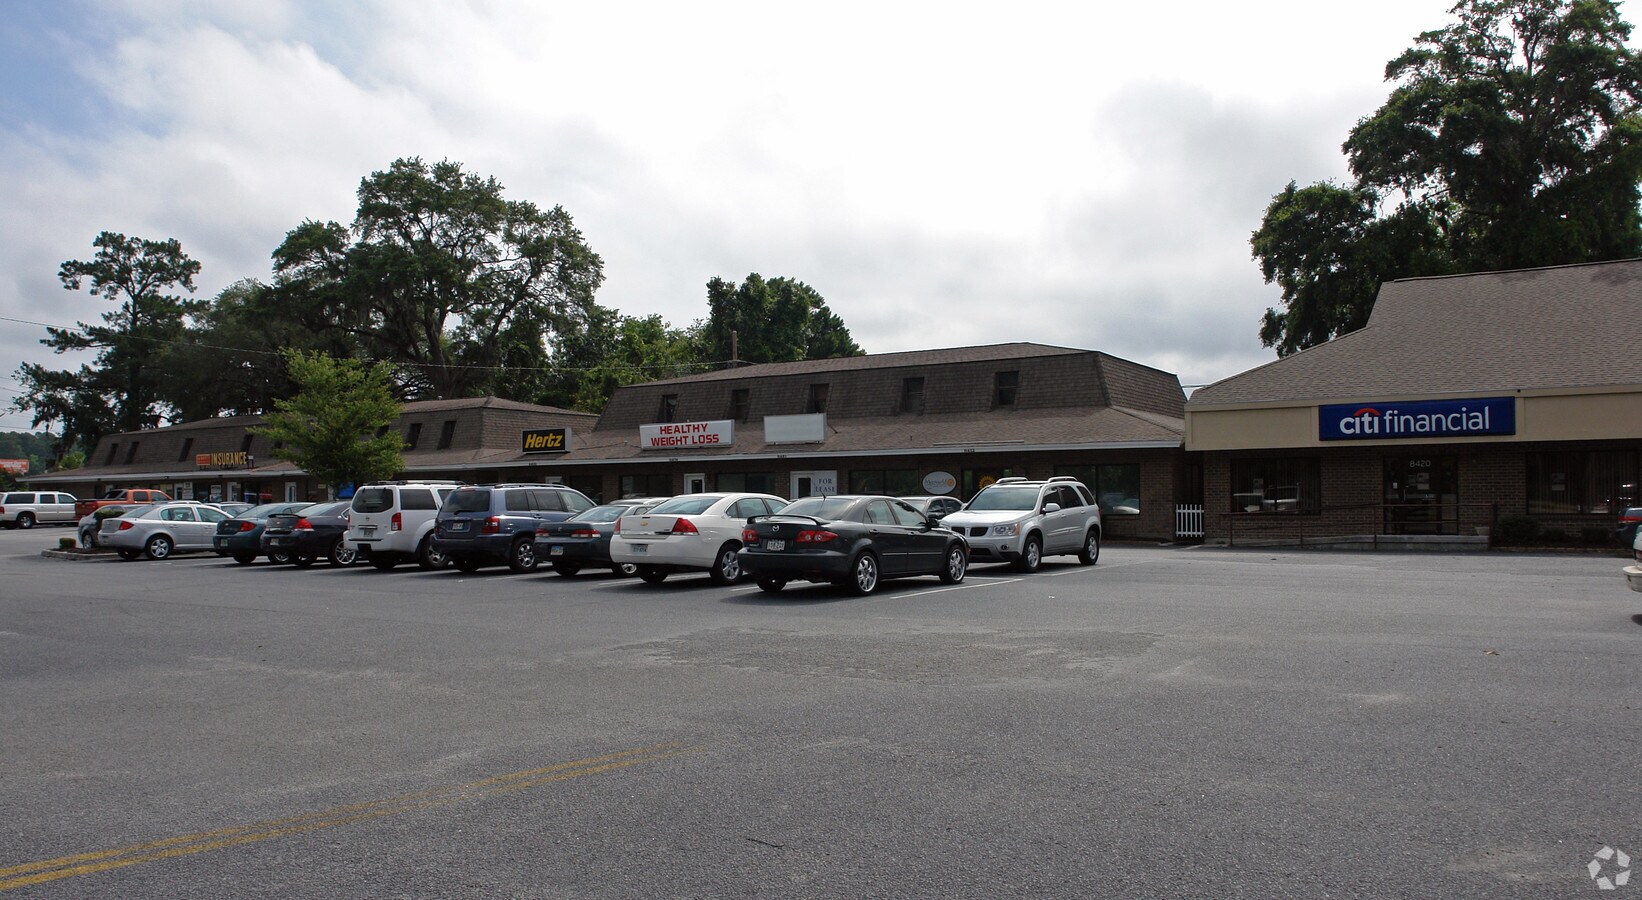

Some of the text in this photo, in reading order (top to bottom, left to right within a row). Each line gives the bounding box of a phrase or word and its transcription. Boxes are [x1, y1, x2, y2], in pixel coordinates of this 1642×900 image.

[1339, 406, 1490, 435] citi financial
[659, 423, 708, 435] HEALTHY
[524, 433, 563, 449] Hertz
[650, 434, 719, 447] WEIGHT LOSS
[210, 451, 247, 466] INSURANCE
[1409, 459, 1431, 467] 8420
